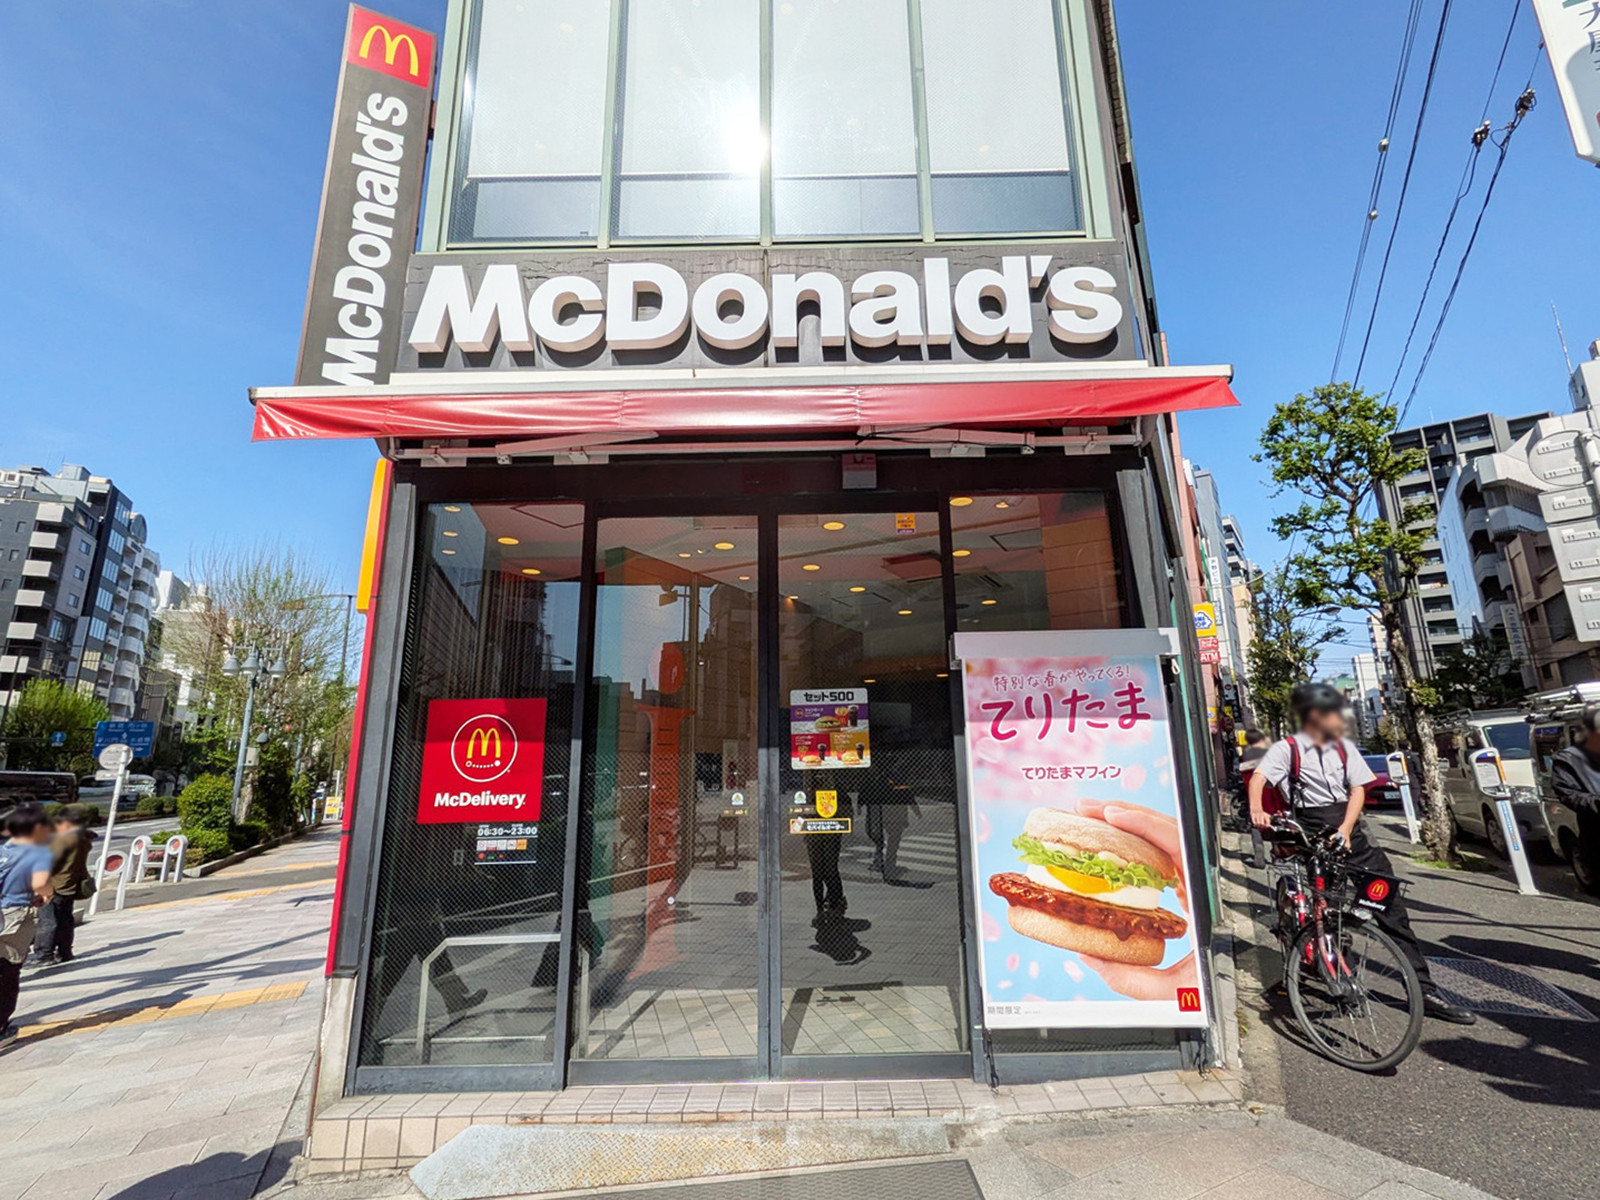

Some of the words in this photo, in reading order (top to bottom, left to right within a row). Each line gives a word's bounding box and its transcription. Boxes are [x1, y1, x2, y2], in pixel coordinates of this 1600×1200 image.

[321, 92, 409, 385] McDonald's
[408, 255, 1125, 354] McDonald's
[1201, 653, 1219, 661] ATM
[804, 691, 854, 702] セット500
[981, 682, 1152, 740] てりたま
[1022, 766, 1122, 780] てりたまマフィン
[434, 791, 526, 809] McDelivery
